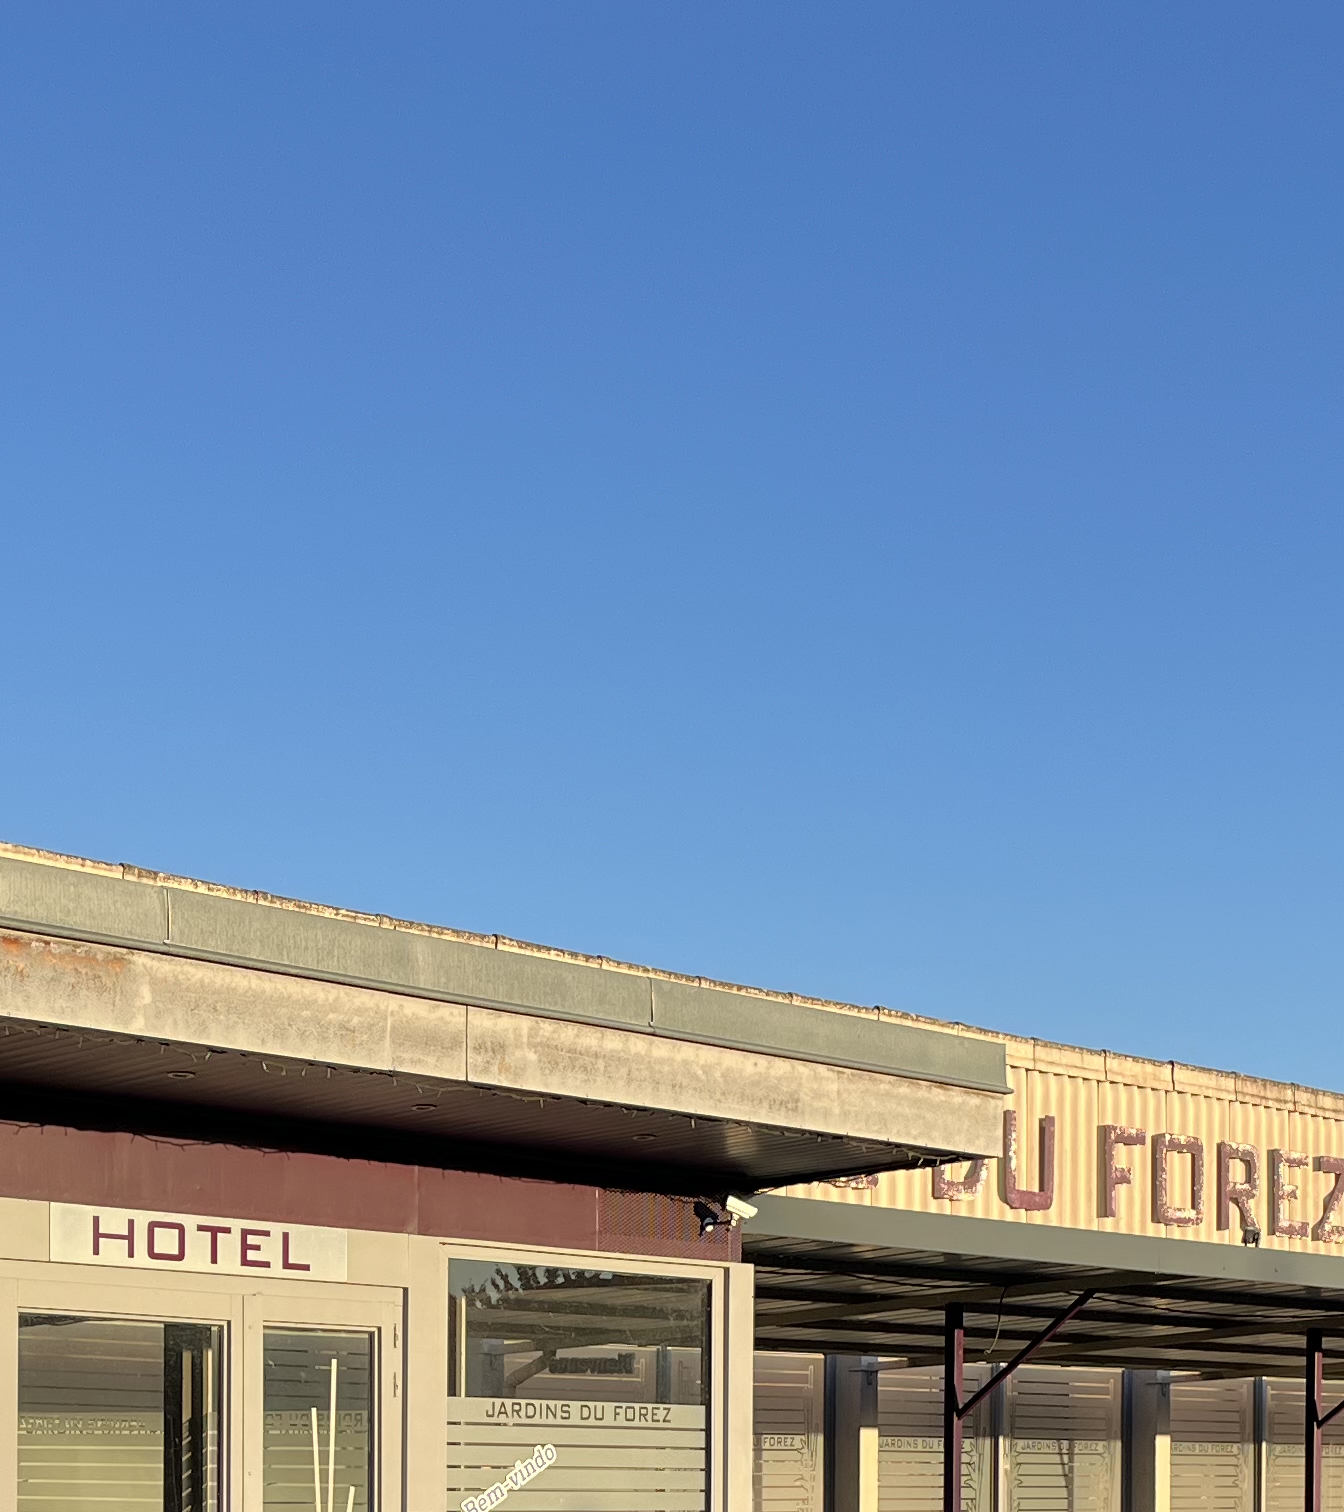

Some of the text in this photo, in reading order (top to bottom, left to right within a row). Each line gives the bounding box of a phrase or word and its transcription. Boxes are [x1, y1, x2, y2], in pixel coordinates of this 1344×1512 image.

[93, 1215, 311, 1271] HOTEL
[486, 1401, 672, 1423] JARDINS DU FOREZ
[763, 1436, 795, 1448] FOREZ
[879, 1438, 918, 1449] JARDINS
[921, 1439, 934, 1449] DU
[1021, 1441, 1057, 1451] JARDINS
